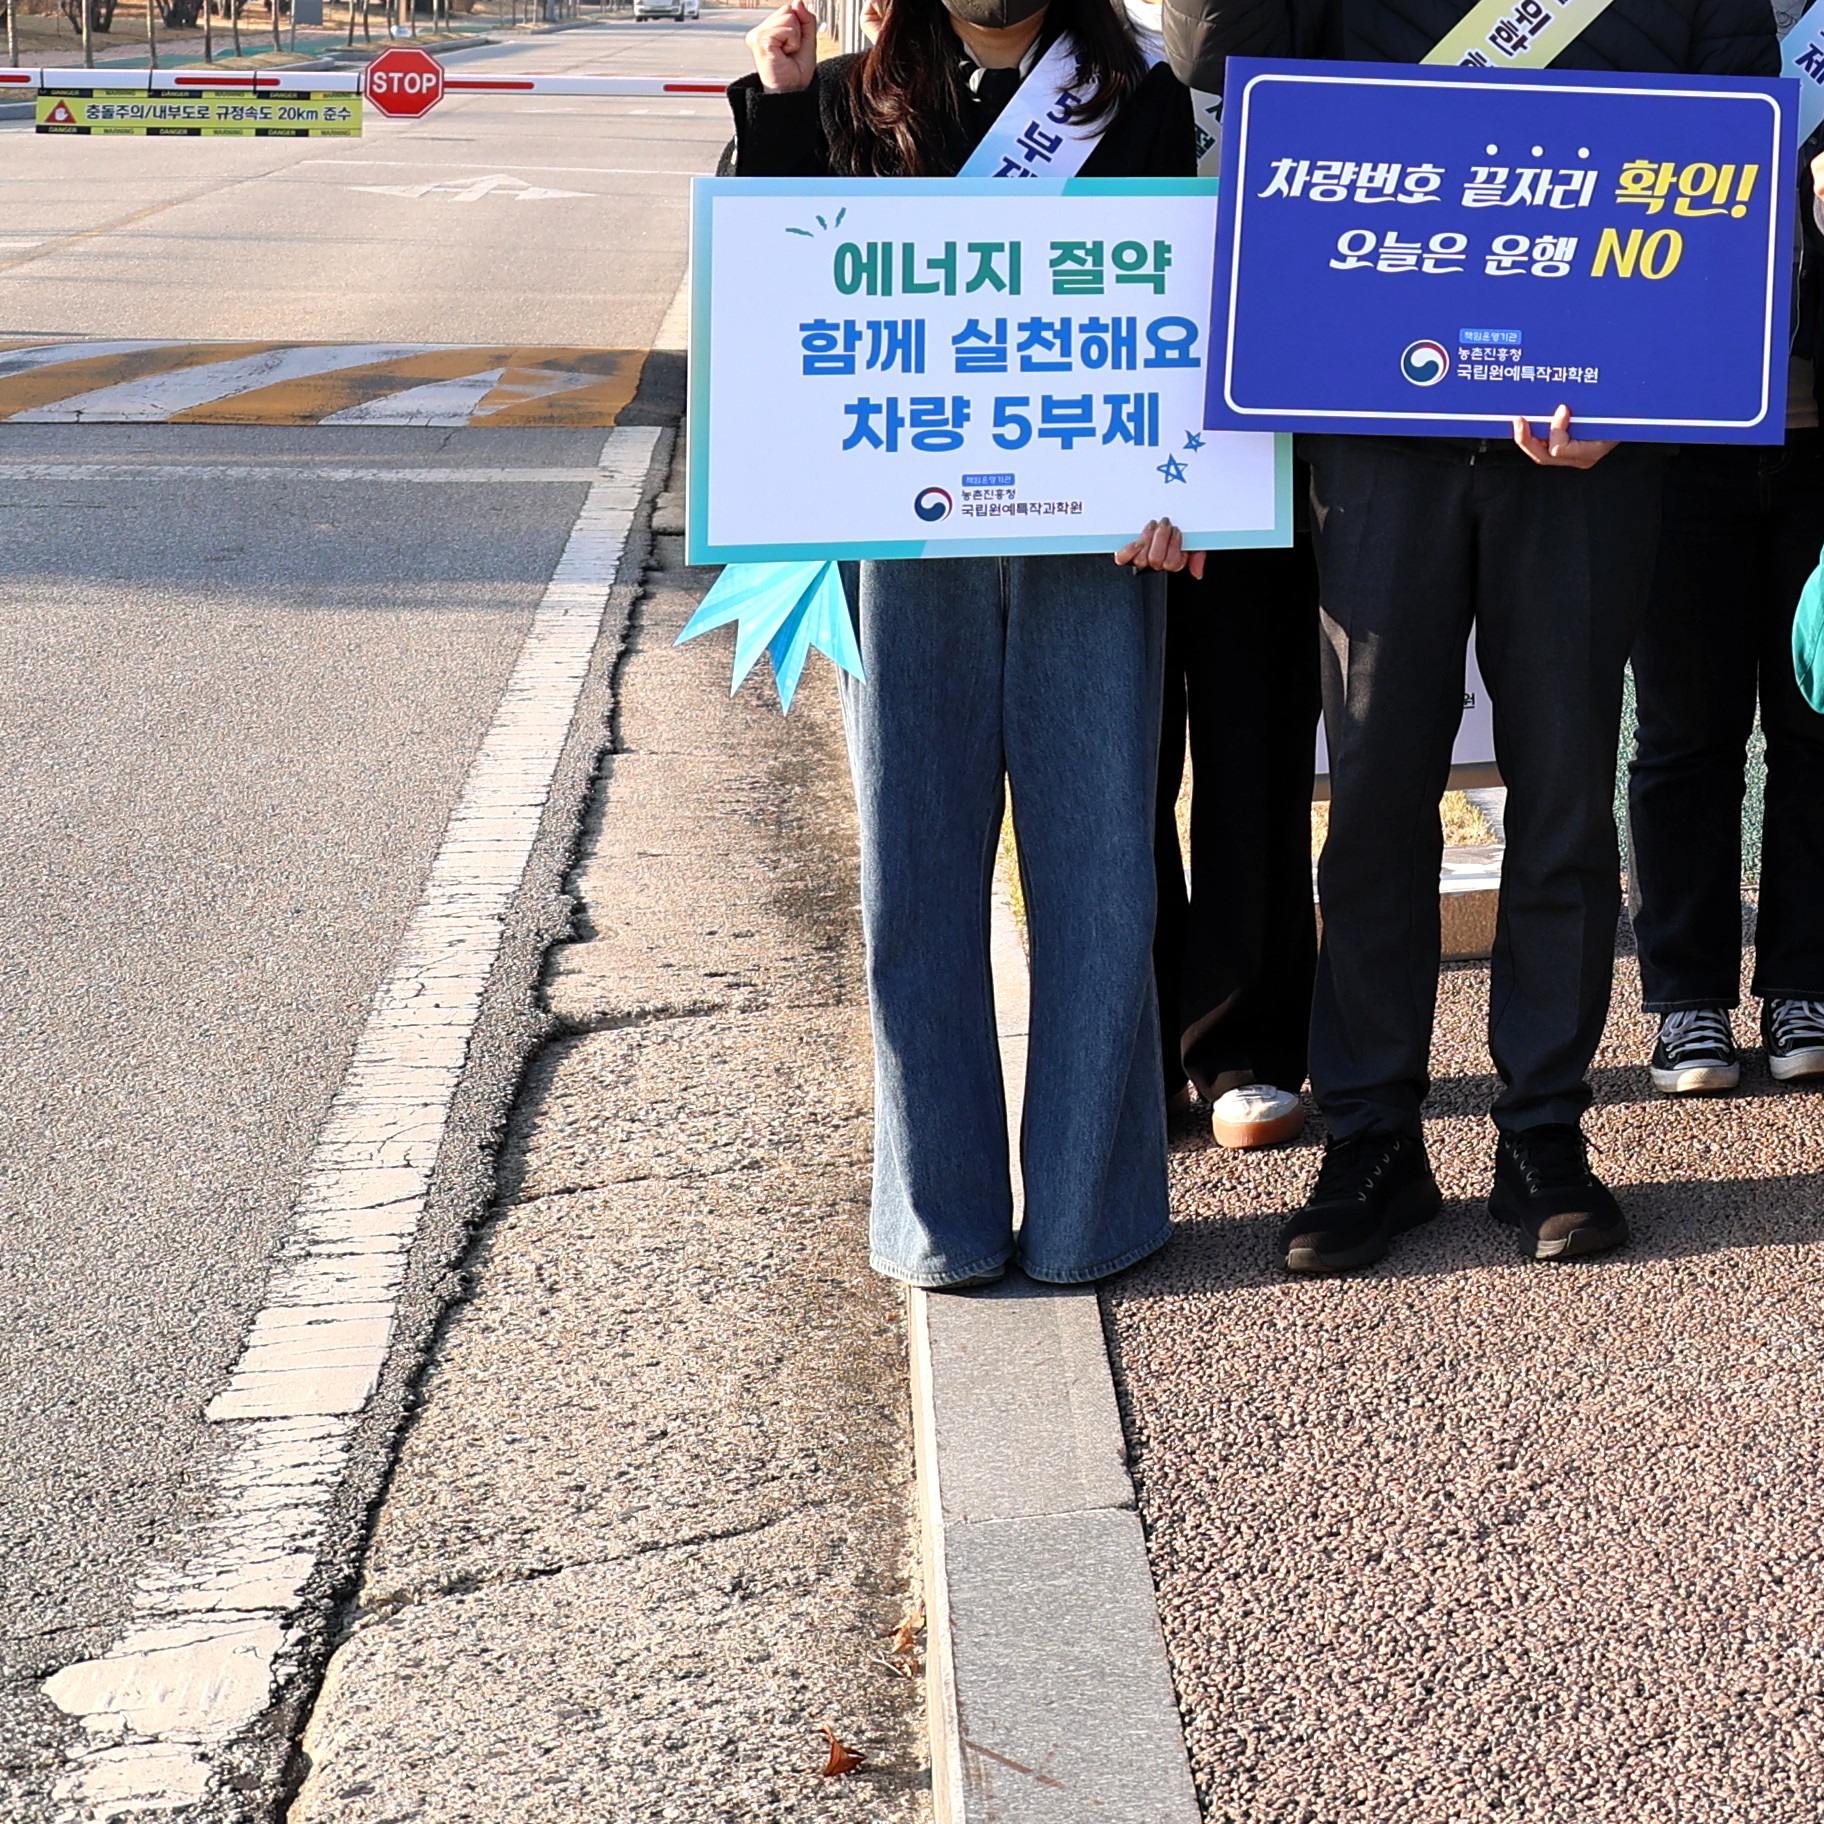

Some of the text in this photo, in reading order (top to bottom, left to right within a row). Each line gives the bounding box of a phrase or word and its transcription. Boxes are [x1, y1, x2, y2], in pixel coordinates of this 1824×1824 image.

[372, 72, 437, 94] STOP
[85, 103, 352, 122] 충돌주의/내부도로 규정속도 20km 준수
[1257, 158, 1759, 218] 차량번호 끝자리 확인!
[1329, 227, 1683, 280] 오늘은 운행 NO
[833, 240, 1172, 297] 에너지 절약
[799, 316, 1202, 376] 함께 실천해요
[1458, 346, 1522, 362] 농촌진흥청
[1457, 364, 1599, 384] 국립원예특작과학원
[842, 392, 1159, 453] 차량 5부제
[961, 488, 1016, 502] 농촌진흥청
[961, 501, 1083, 518] 국립원예특작과학원
